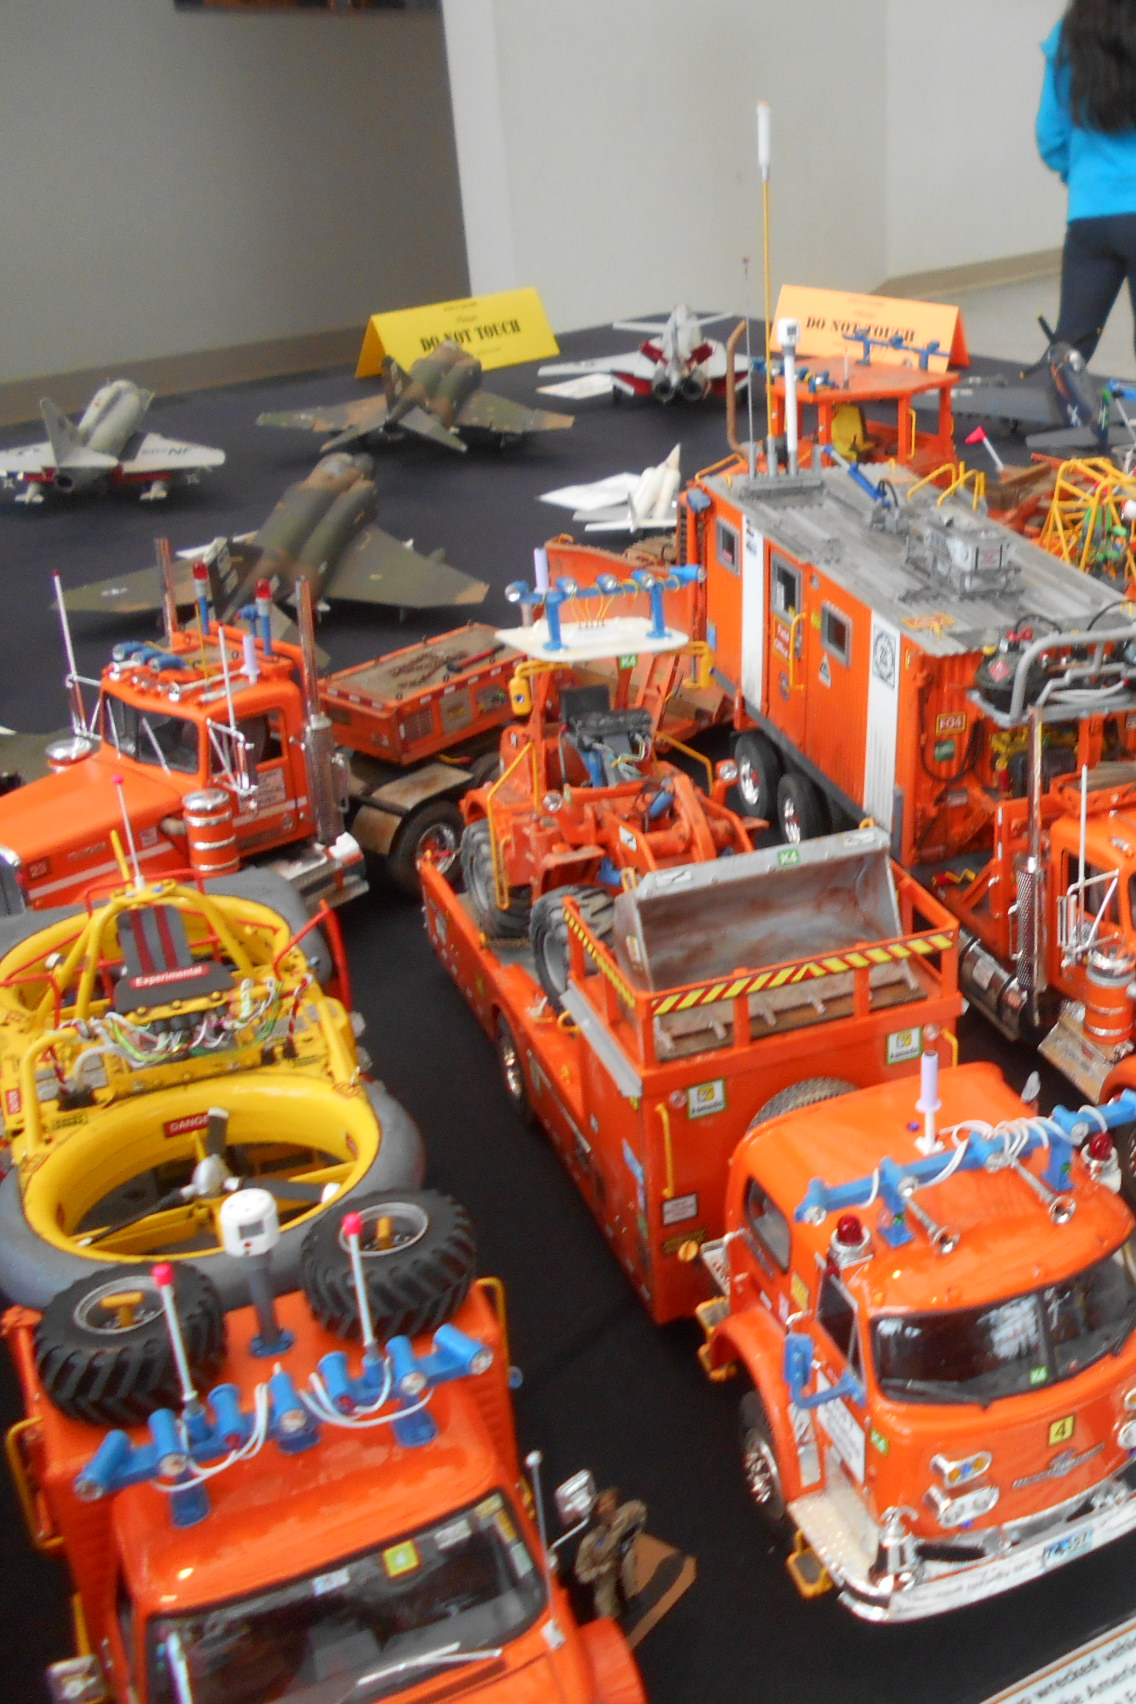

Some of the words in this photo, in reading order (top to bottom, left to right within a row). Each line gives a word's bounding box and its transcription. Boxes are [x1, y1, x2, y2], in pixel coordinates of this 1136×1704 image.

[806, 316, 826, 331] DO
[420, 335, 440, 353] DO
[474, 318, 521, 341] TOUCH
[134, 965, 203, 987] Experimental
[1054, 1420, 1068, 1440] 4
